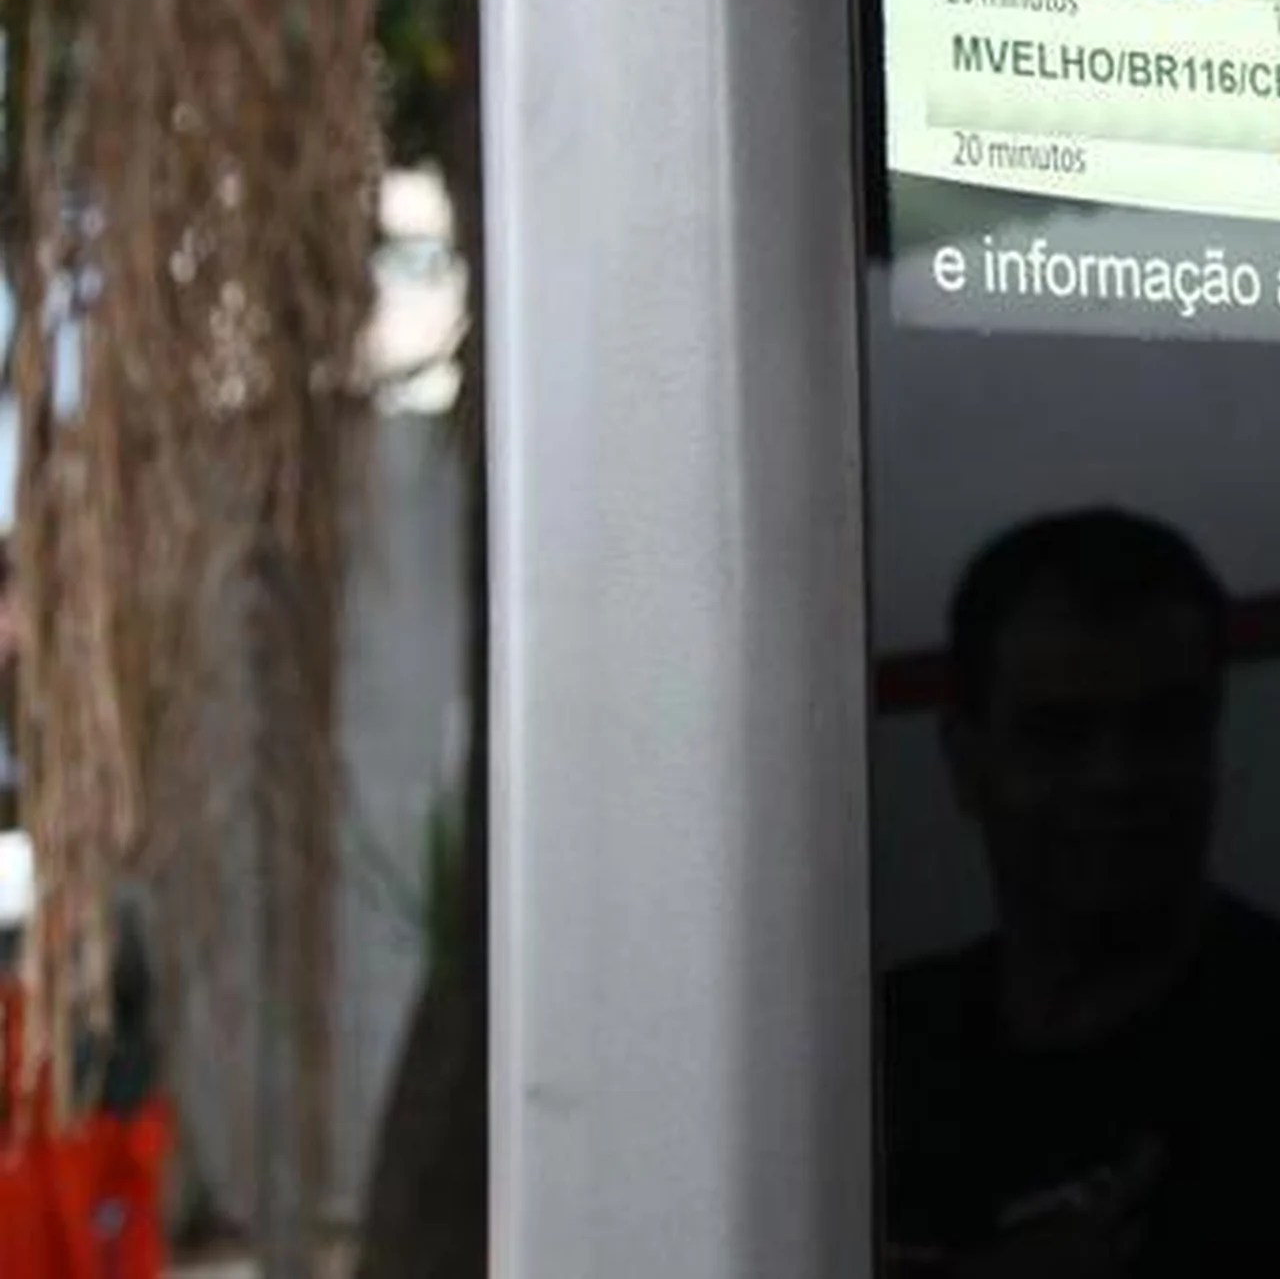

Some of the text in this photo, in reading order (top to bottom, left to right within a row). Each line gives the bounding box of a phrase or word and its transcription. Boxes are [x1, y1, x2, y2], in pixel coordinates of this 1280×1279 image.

[951, 131, 1086, 173] 20 minutos
[932, 244, 965, 293] e
[983, 235, 1260, 317] informação
